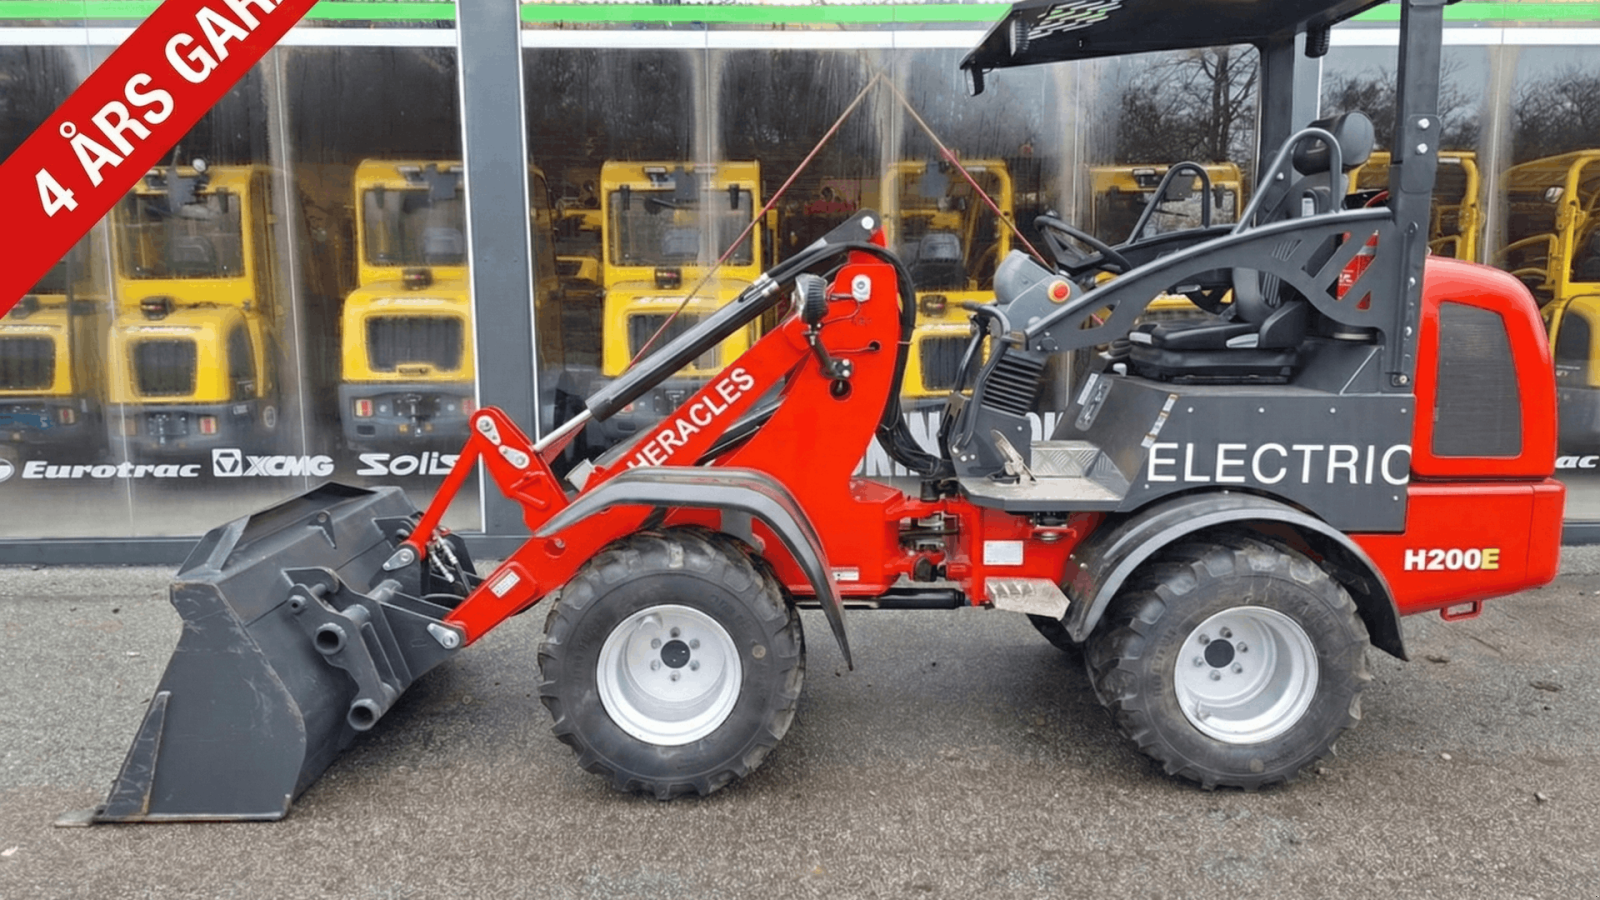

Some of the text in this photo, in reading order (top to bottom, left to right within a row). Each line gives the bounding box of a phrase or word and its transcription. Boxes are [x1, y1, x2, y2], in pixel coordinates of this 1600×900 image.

[626, 367, 754, 467] HERACLES
[22, 460, 201, 479] Eurotrac
[243, 455, 334, 476] XCMG
[356, 451, 461, 476] Solis
[1147, 442, 1413, 486] ELECTRIC
[1404, 548, 1500, 571] H200E
